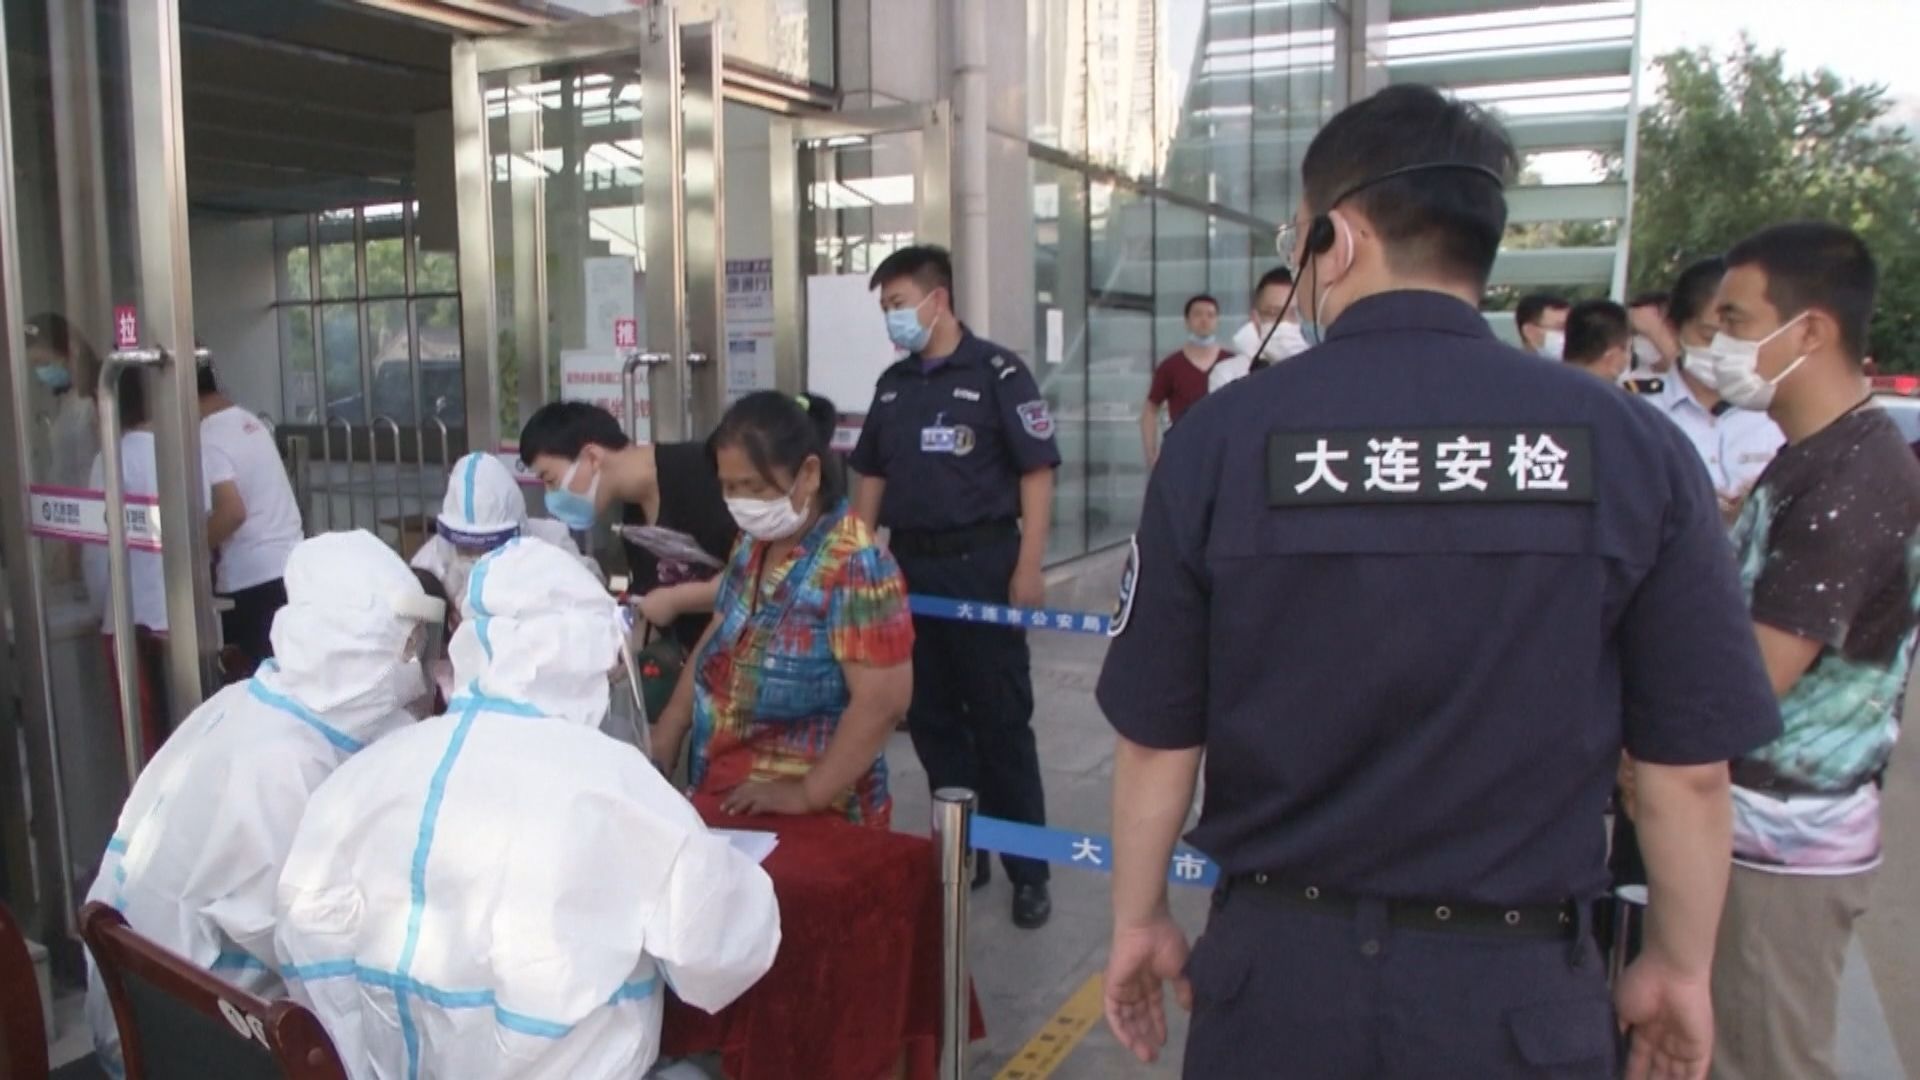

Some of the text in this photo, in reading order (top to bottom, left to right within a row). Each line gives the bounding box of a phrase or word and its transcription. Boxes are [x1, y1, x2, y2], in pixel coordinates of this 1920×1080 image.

[120, 311, 137, 344] 拉
[617, 321, 636, 344] 推
[1295, 433, 1570, 494] 大连安检
[957, 603, 1100, 632] 大连市公安局
